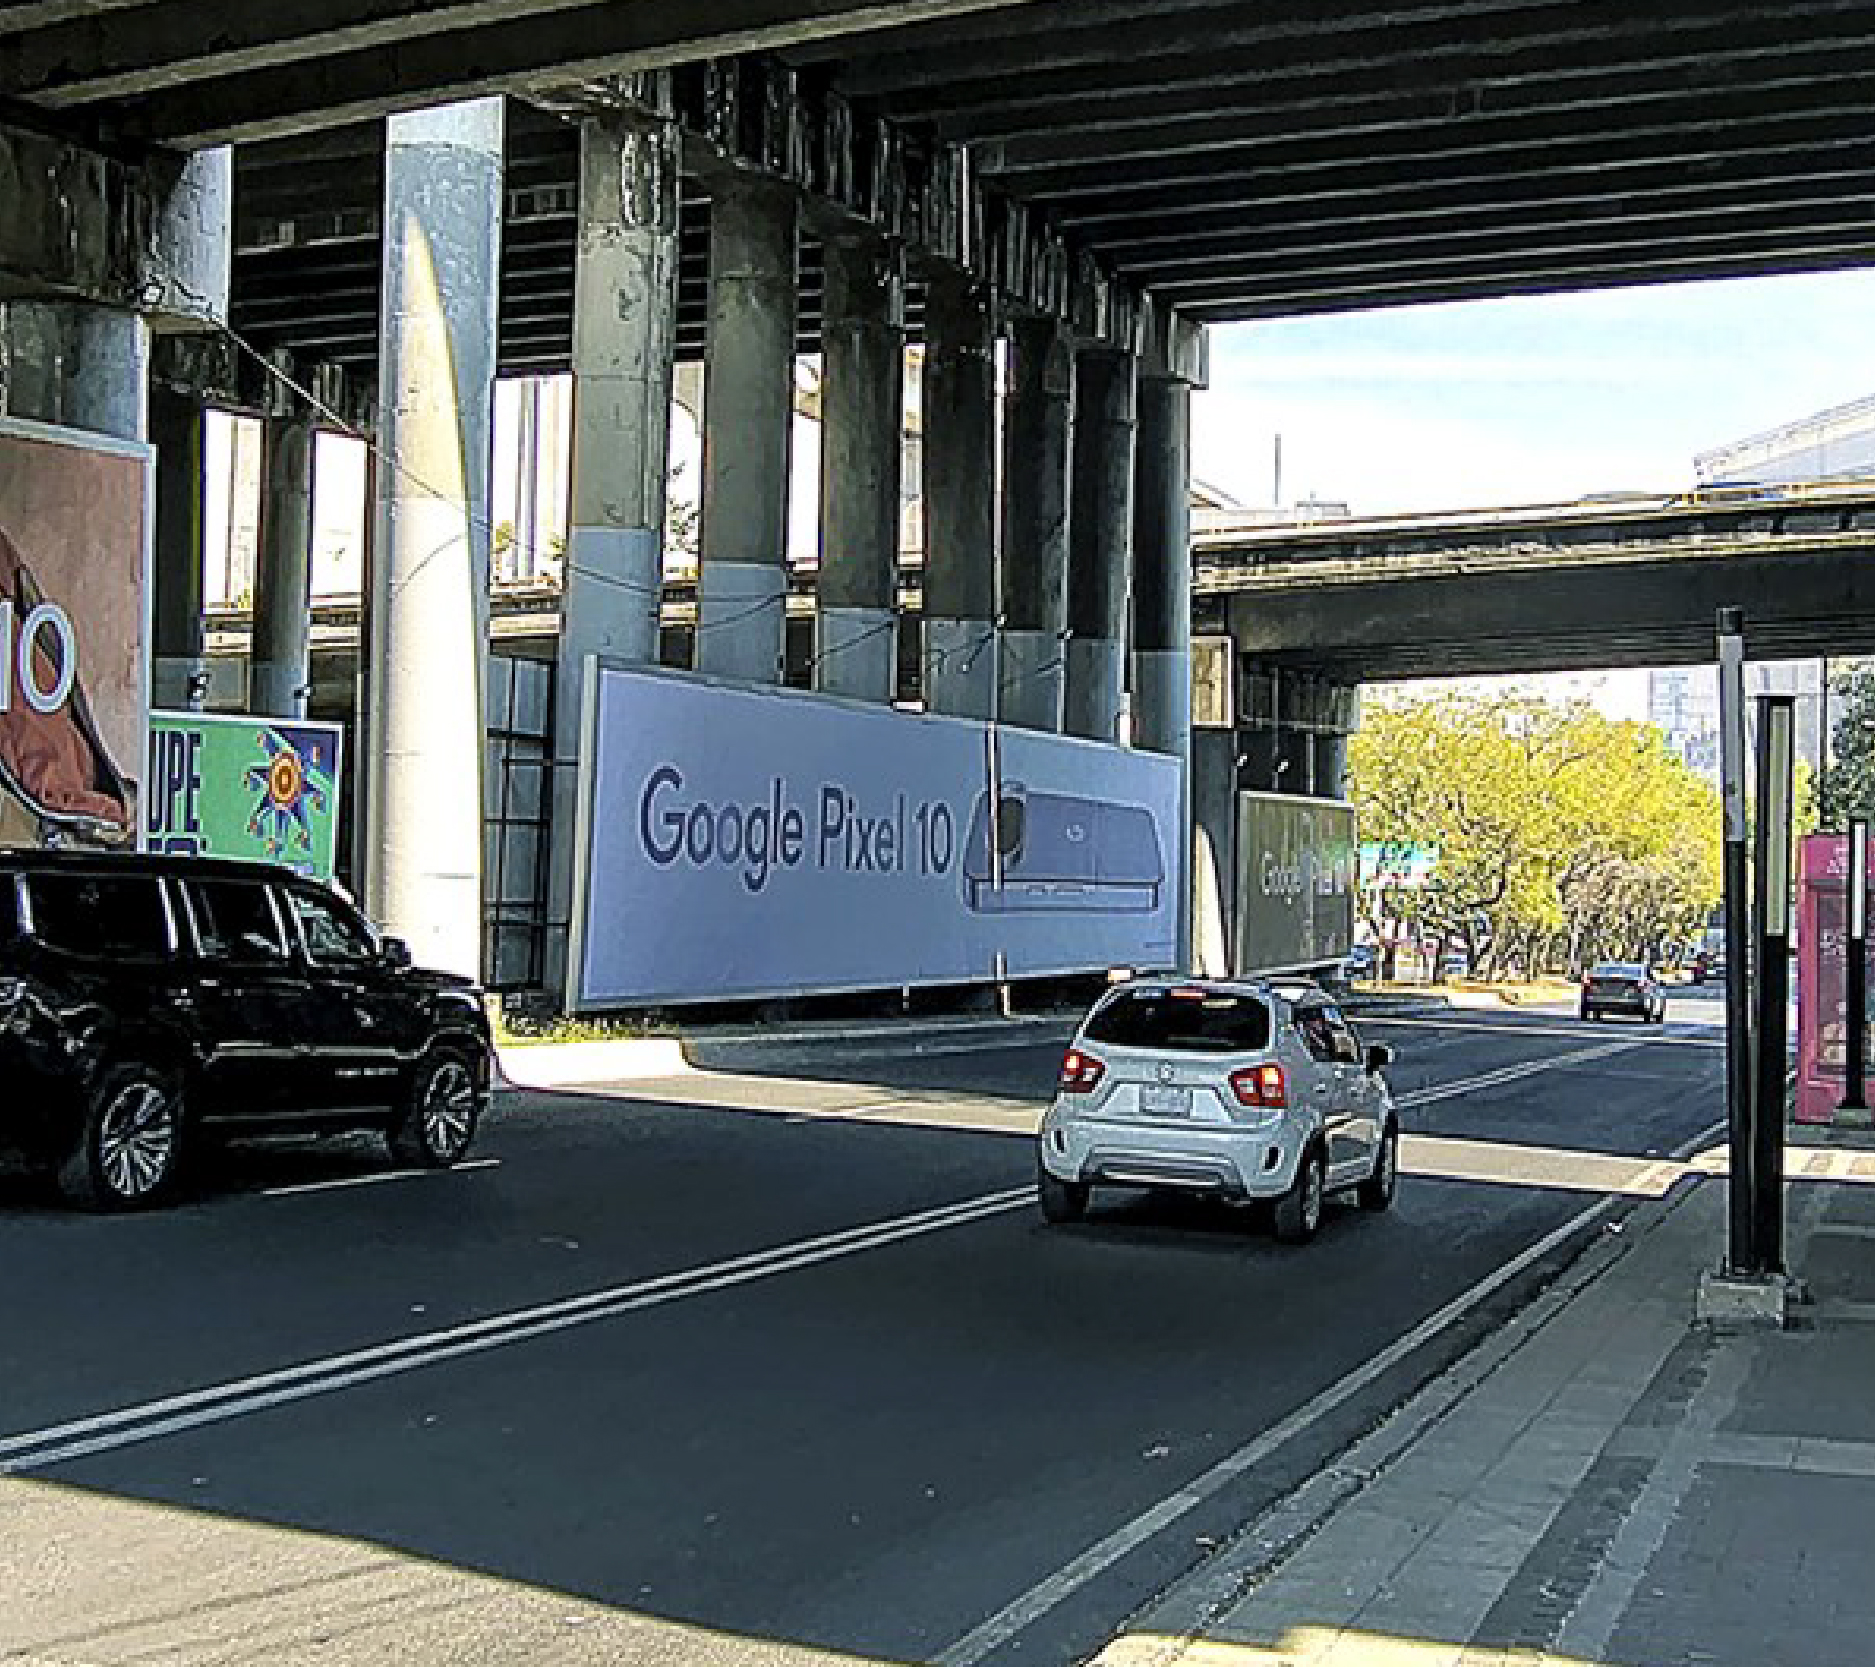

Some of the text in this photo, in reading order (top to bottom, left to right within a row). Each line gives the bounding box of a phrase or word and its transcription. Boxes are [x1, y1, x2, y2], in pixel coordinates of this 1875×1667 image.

[641, 766, 954, 891] Google Pixel 10
